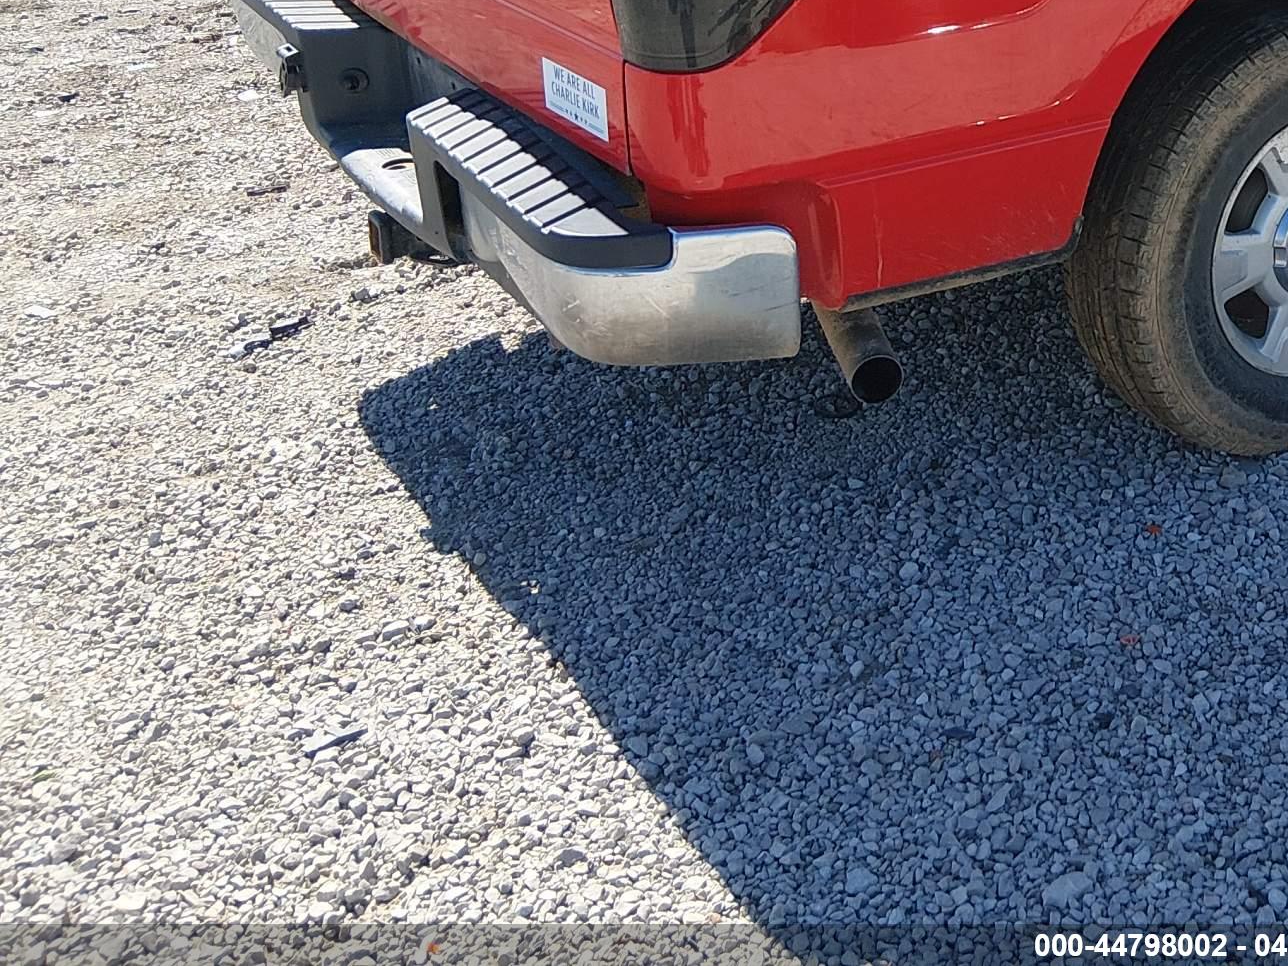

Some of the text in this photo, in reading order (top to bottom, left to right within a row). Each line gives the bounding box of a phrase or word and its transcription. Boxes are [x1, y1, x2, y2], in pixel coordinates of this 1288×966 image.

[551, 81, 600, 120] CHARLIE KIRK
[553, 65, 596, 100] WE ARE ALL
